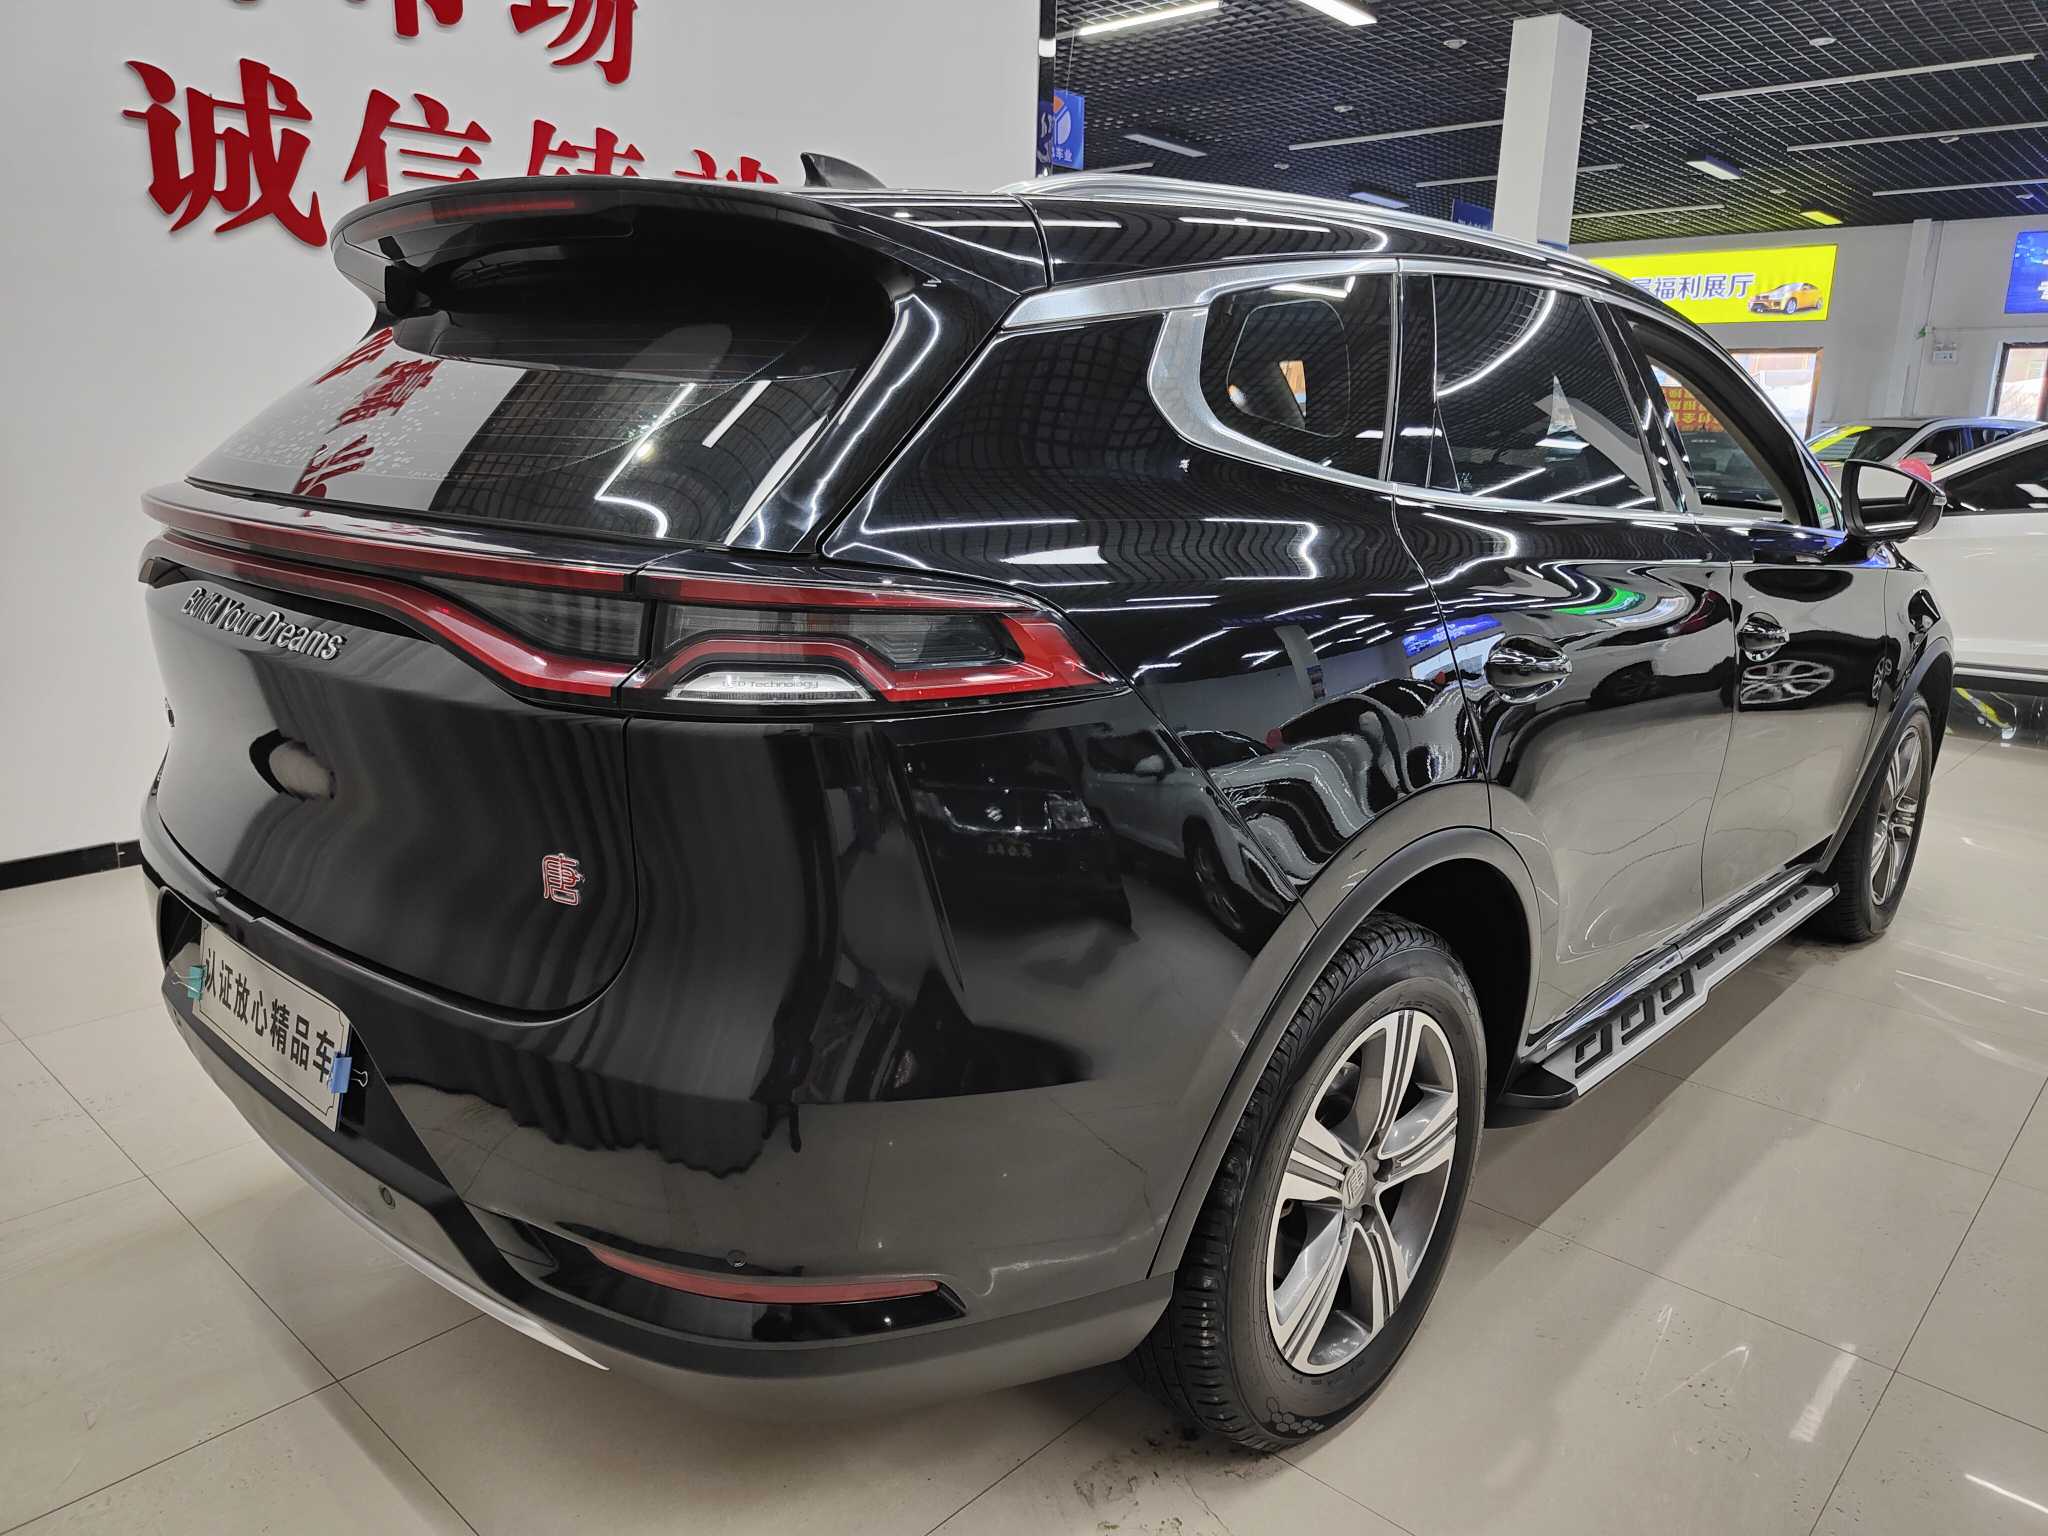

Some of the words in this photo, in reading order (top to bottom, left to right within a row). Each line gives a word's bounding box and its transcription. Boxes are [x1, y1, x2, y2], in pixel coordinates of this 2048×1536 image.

[181, 586, 227, 624] Build
[216, 599, 262, 637] Your
[253, 610, 344, 660] Dreams
[204, 948, 336, 1083] 认证放心精品车
